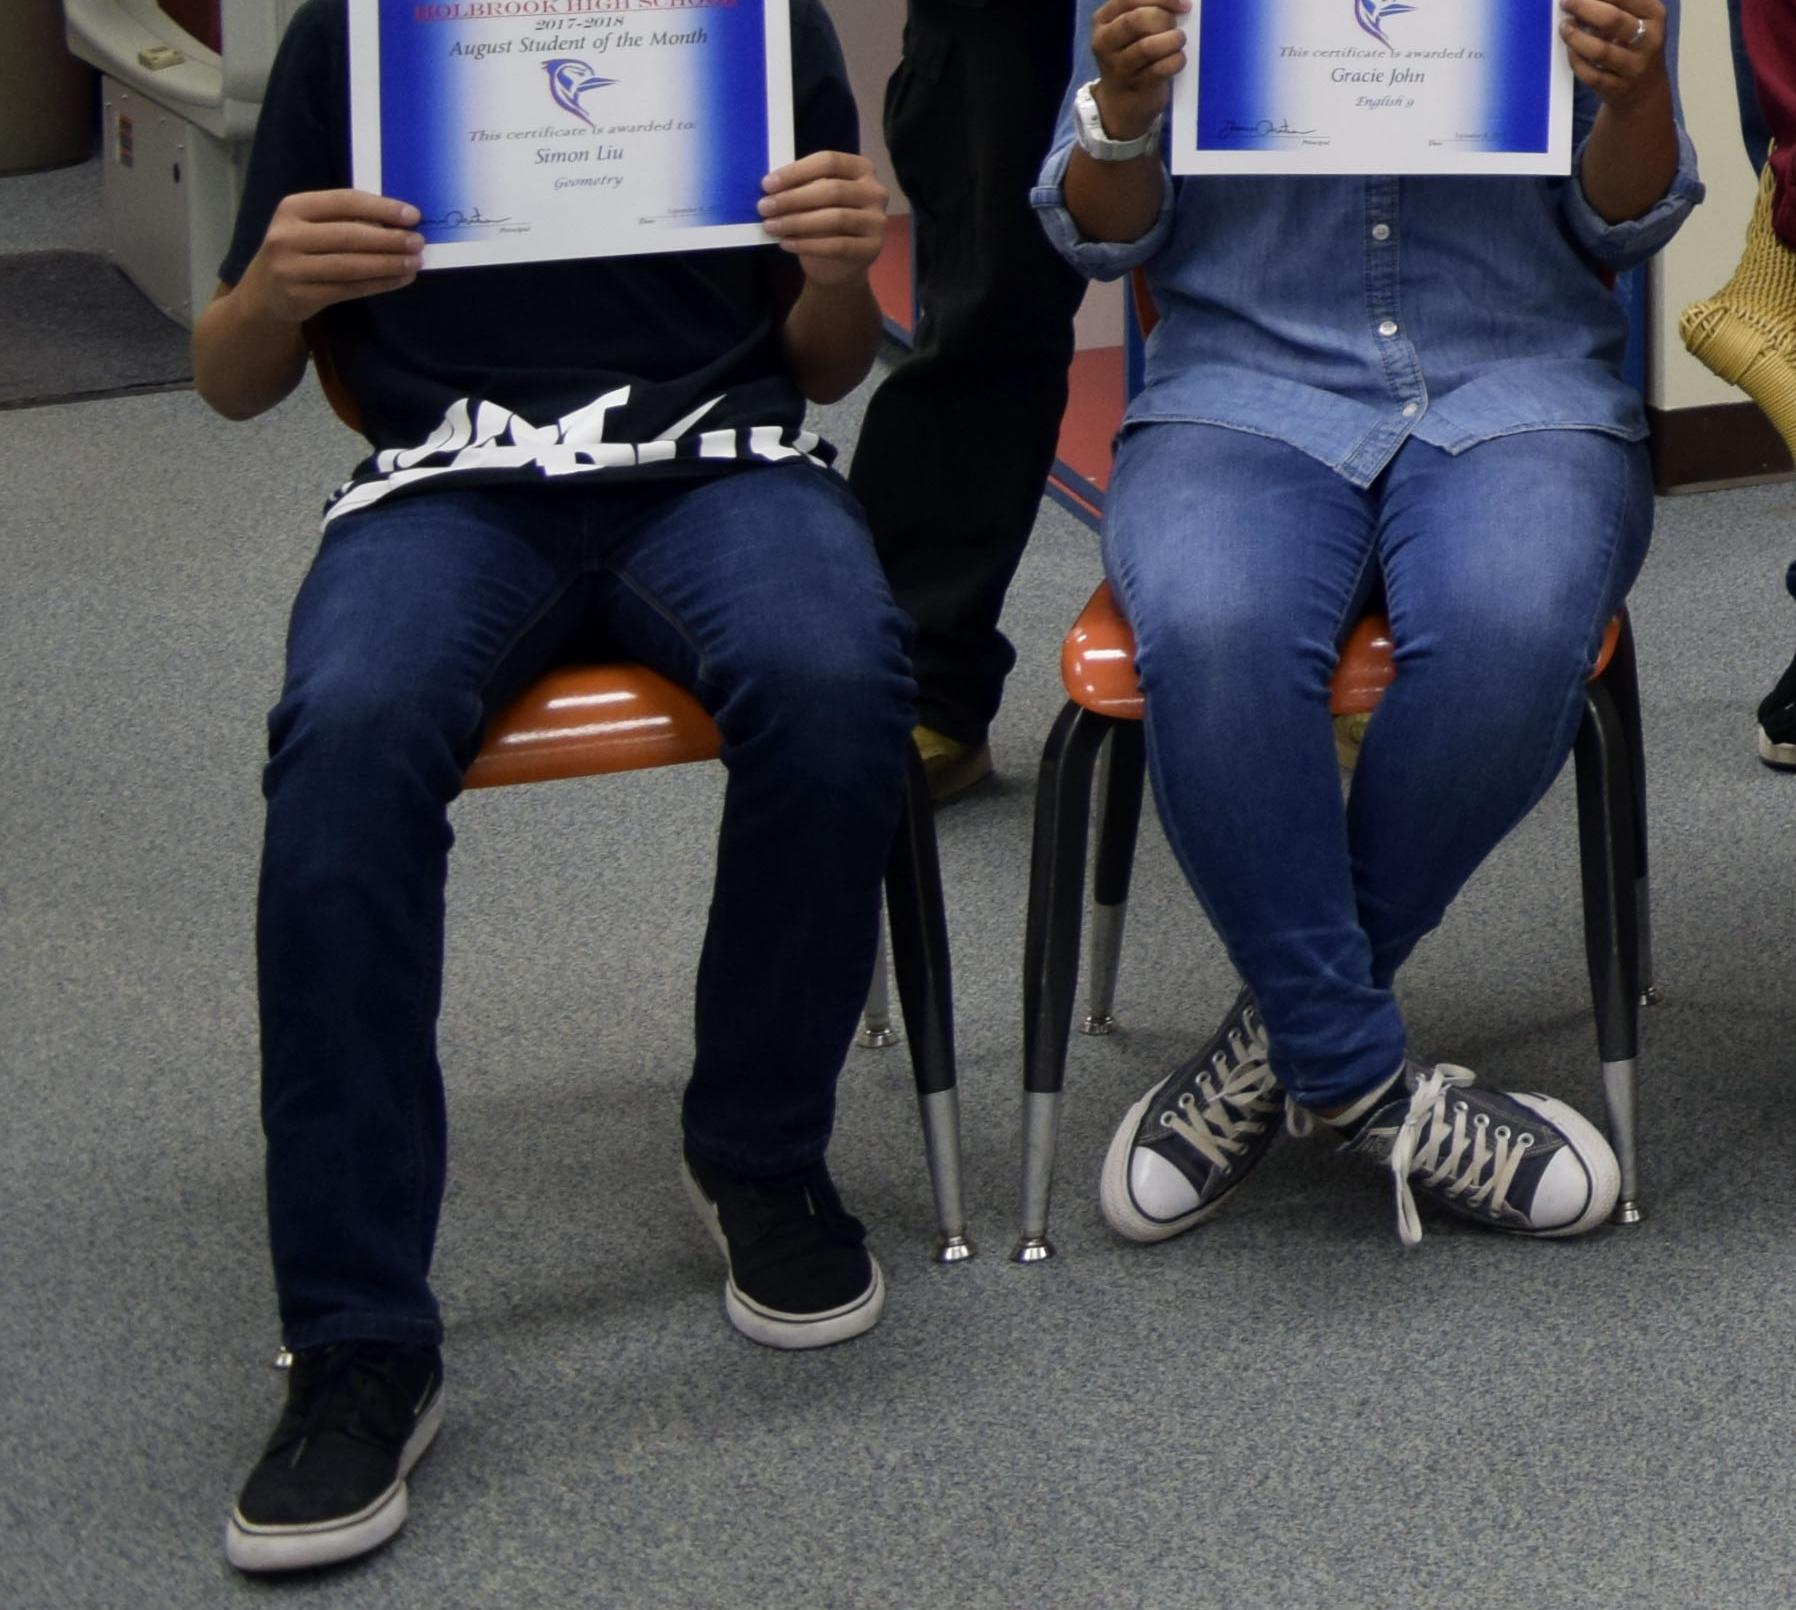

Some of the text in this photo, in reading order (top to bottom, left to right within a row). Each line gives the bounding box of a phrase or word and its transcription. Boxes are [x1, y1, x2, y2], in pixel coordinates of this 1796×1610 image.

[533, 14, 625, 31] 2017-2018
[447, 26, 709, 61] August Student of the Month
[1330, 67, 1426, 86] Gracie John
[534, 143, 624, 165] Simon Liu
